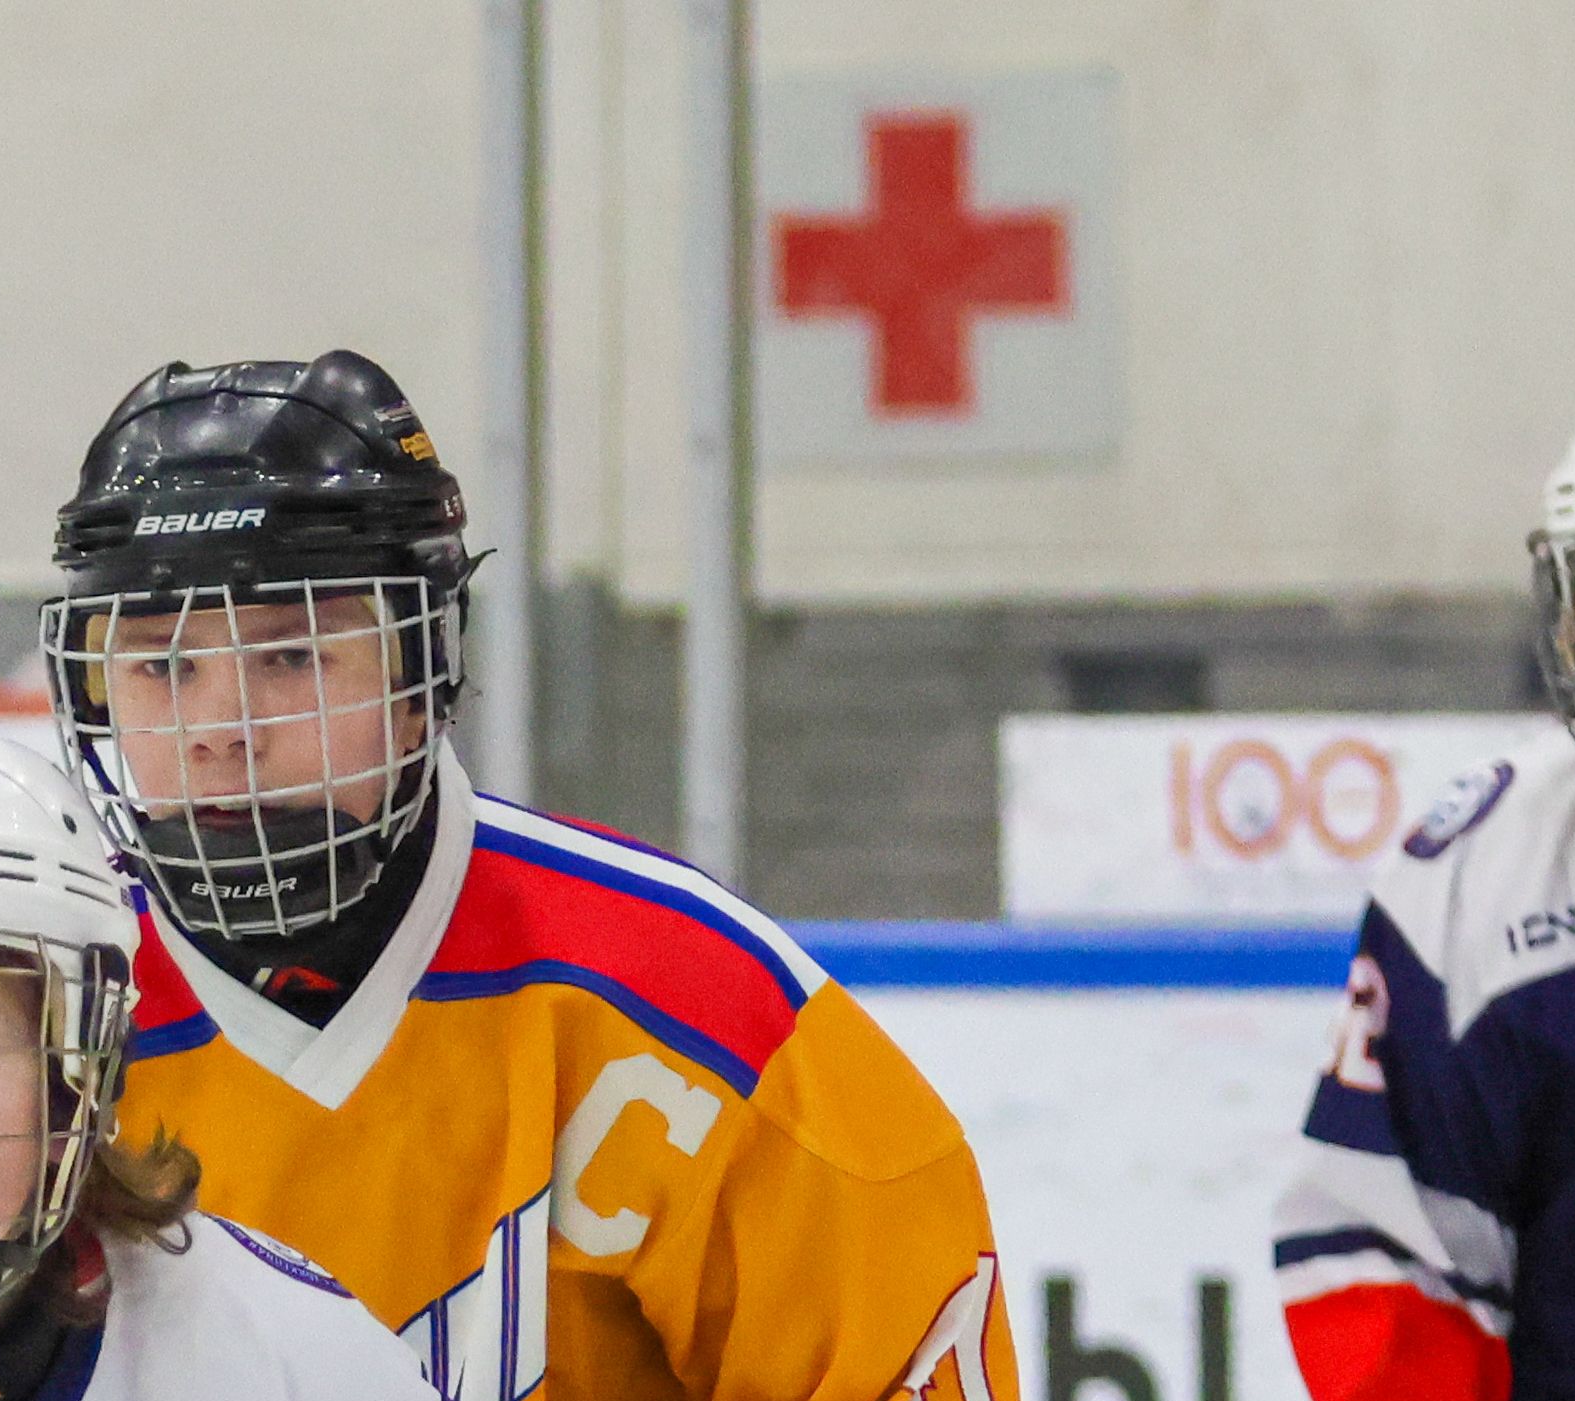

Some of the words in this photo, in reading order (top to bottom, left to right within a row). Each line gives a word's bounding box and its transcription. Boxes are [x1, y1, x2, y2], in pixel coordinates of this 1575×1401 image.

[134, 508, 266, 536] BAUER
[1171, 737, 1400, 862] 100
[551, 1054, 722, 1257] C
